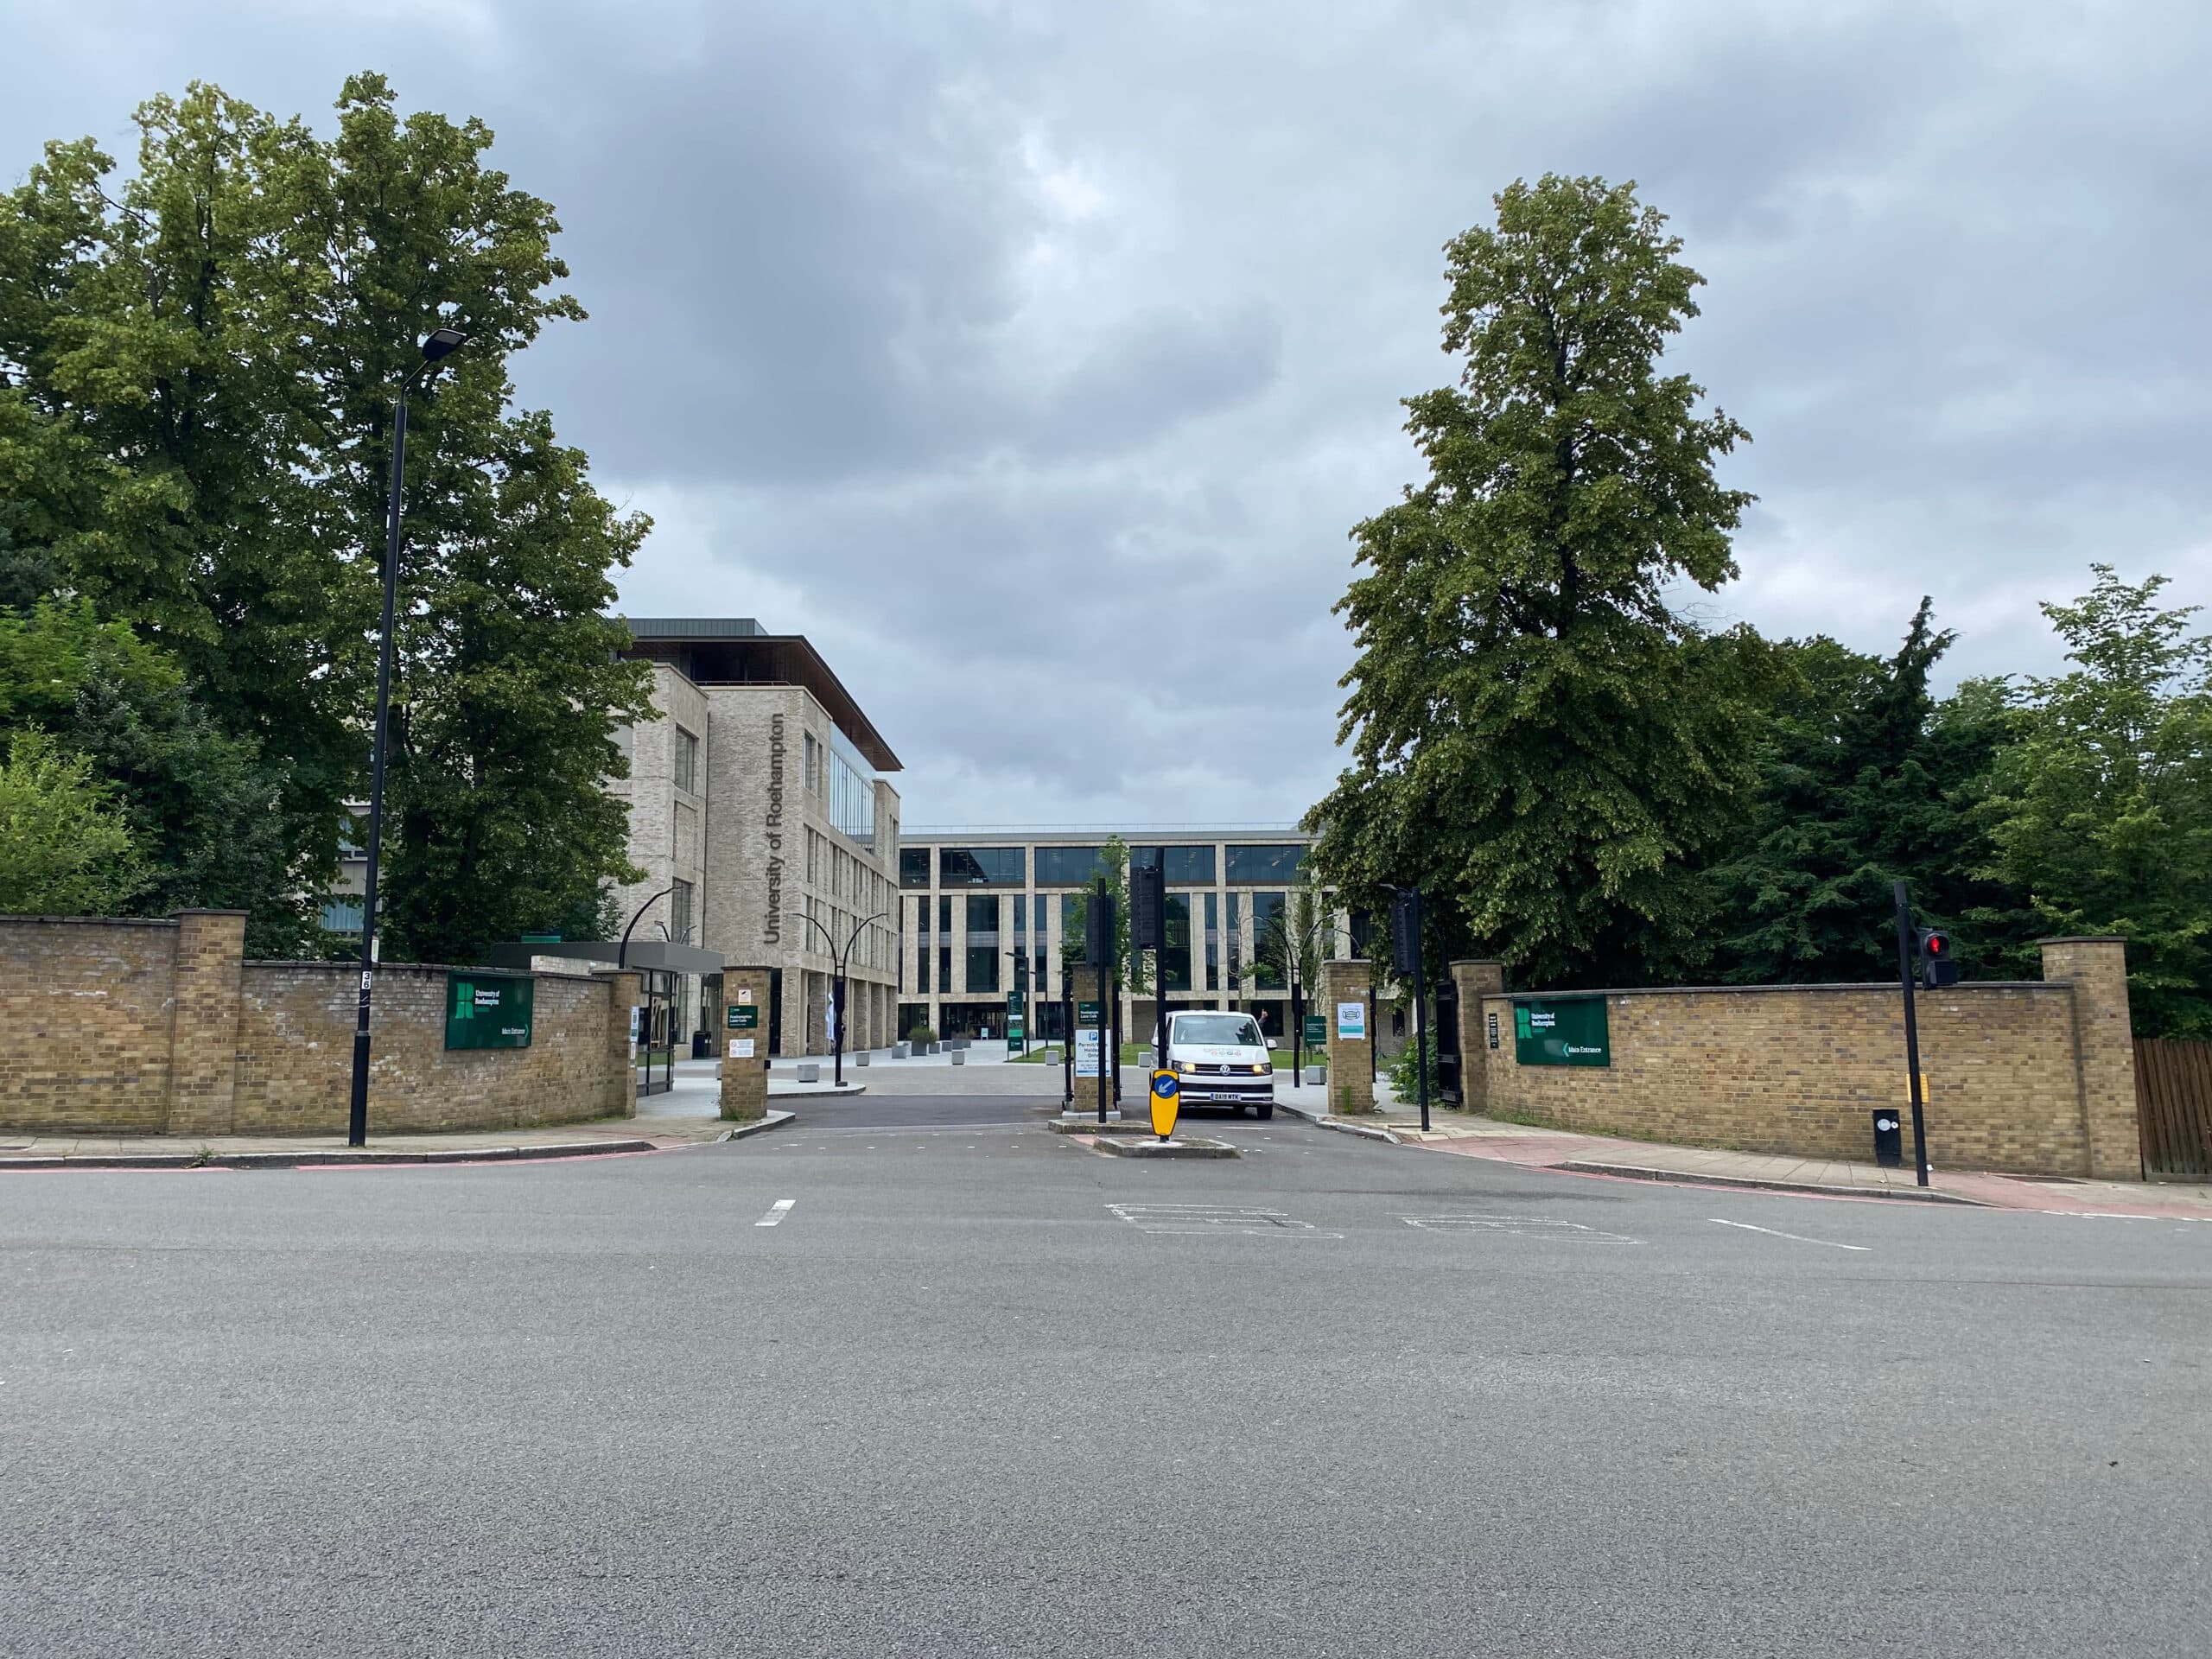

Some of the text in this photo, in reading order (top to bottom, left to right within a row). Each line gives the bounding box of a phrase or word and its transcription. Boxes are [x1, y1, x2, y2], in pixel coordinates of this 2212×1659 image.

[763, 713, 787, 944] University of Roehampton
